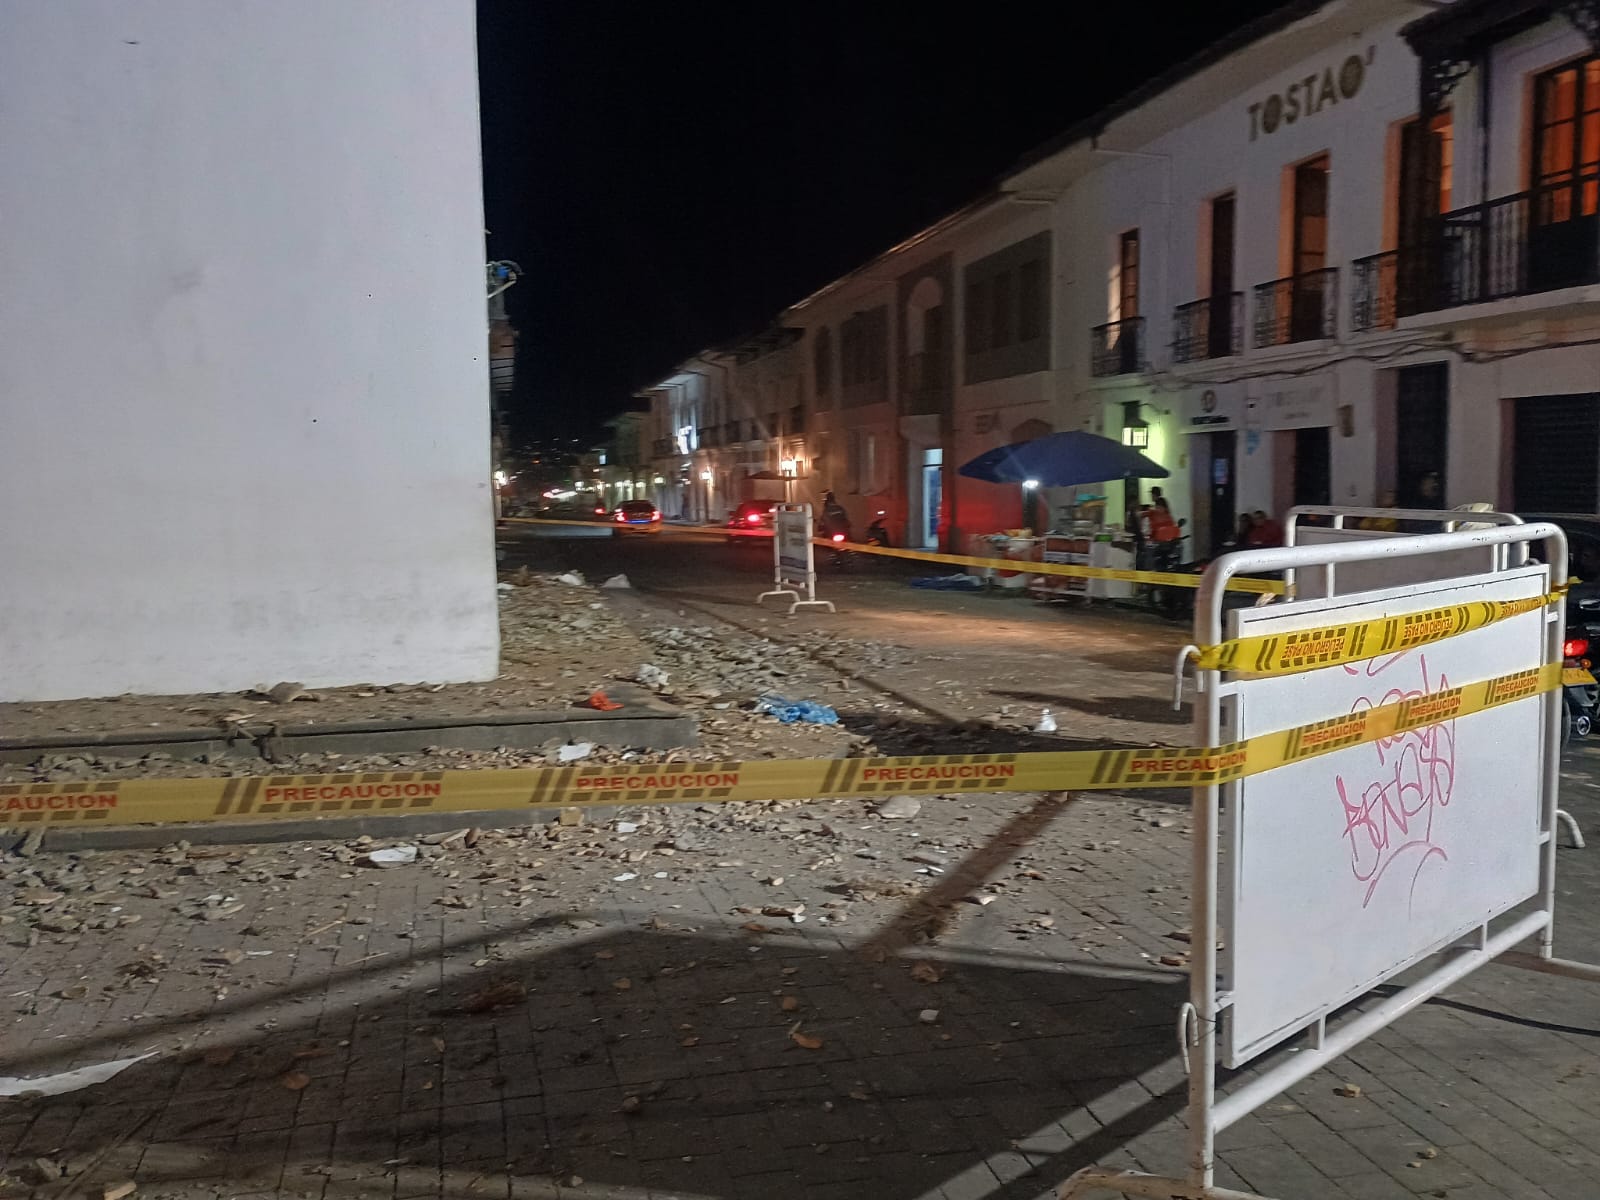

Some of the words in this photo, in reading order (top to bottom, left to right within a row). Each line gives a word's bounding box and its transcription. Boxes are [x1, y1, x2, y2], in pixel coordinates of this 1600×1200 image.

[1404, 624, 1419, 638] PASE
[1430, 617, 1453, 632] PELIGRO
[1282, 645, 1303, 659] PASE
[1303, 643, 1315, 656] NO
[1314, 638, 1345, 654] PELIGRO
[1496, 676, 1539, 695] PRECAUCION
[1409, 697, 1461, 718] PRECAUCION
[1303, 719, 1366, 745] PRECAUCION
[1130, 750, 1247, 773] PRECAUCION
[863, 764, 1015, 781] PRECAUCION
[576, 773, 739, 791] PRECAUCION
[265, 783, 441, 802] PRECAUCION
[0, 794, 117, 810] AUCION
